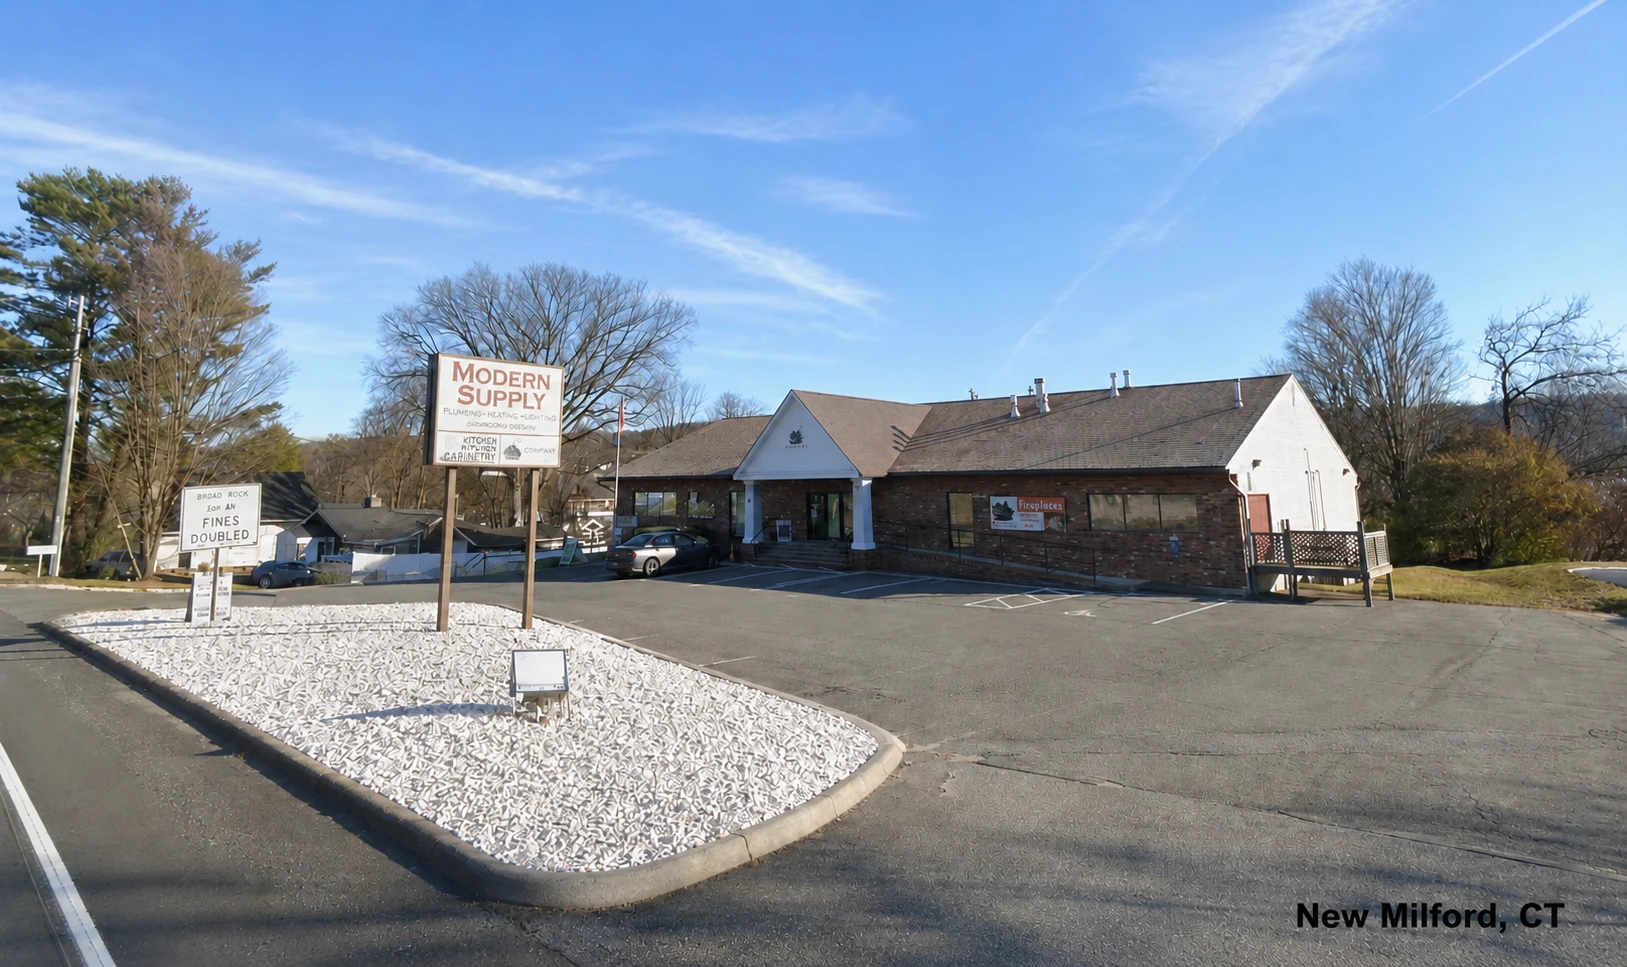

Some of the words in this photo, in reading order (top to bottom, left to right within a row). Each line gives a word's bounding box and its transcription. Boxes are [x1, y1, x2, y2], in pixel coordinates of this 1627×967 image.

[452, 361, 551, 390] MODERN
[457, 385, 546, 410] SUPPLY
[443, 407, 482, 418] PLUMBING
[463, 436, 497, 445] KITCHEN
[197, 492, 223, 500] BROAD
[228, 490, 249, 498] ROCK
[1019, 500, 1063, 511] Fireplaces
[202, 515, 240, 529] FINES
[190, 529, 250, 544] DOUBLED
